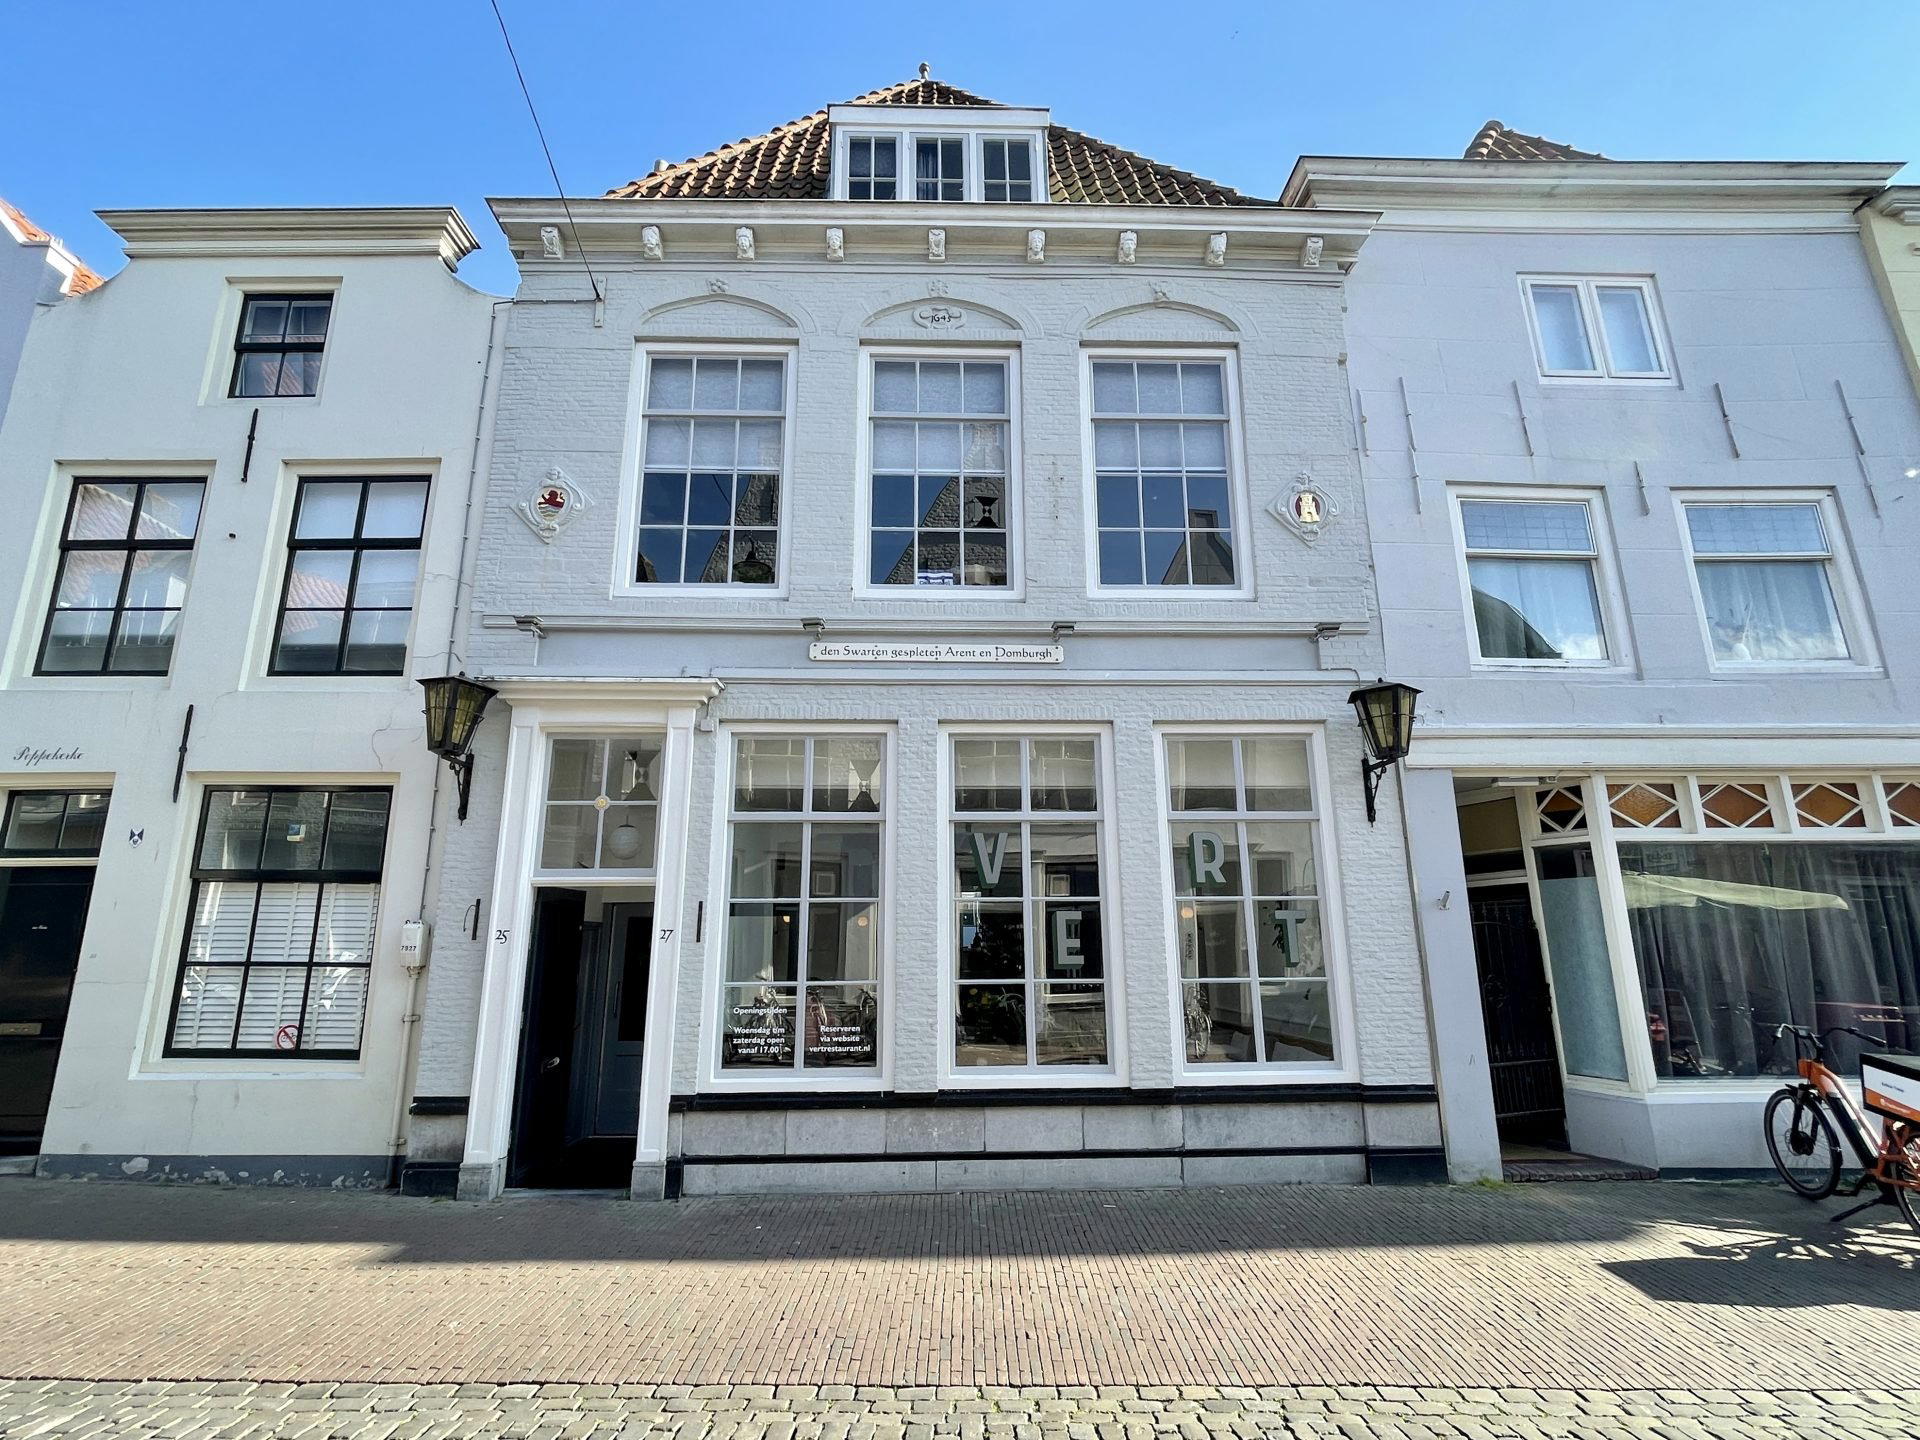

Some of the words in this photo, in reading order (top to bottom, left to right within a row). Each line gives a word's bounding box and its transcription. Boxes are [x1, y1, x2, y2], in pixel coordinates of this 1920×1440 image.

[820, 645, 840, 656] den
[842, 645, 888, 656] Swarten
[891, 647, 942, 659] gespleten
[944, 646, 976, 657] Arent
[995, 646, 1052, 660] Domburgh
[13, 746, 85, 767] Poppekerke
[495, 929, 510, 945] 25
[660, 929, 674, 943] 27
[733, 1007, 788, 1016] Openingstijden
[733, 1026, 771, 1036] Woensdag
[820, 1025, 861, 1033] Reserveren
[732, 1036, 766, 1045] zaterdag
[766, 1037, 785, 1045] open
[820, 1034, 831, 1042] via
[832, 1034, 860, 1042] website
[737, 1046, 758, 1054] vanaf
[760, 1046, 780, 1054] 17.00
[808, 1044, 871, 1053] vertrestaurant.nl
